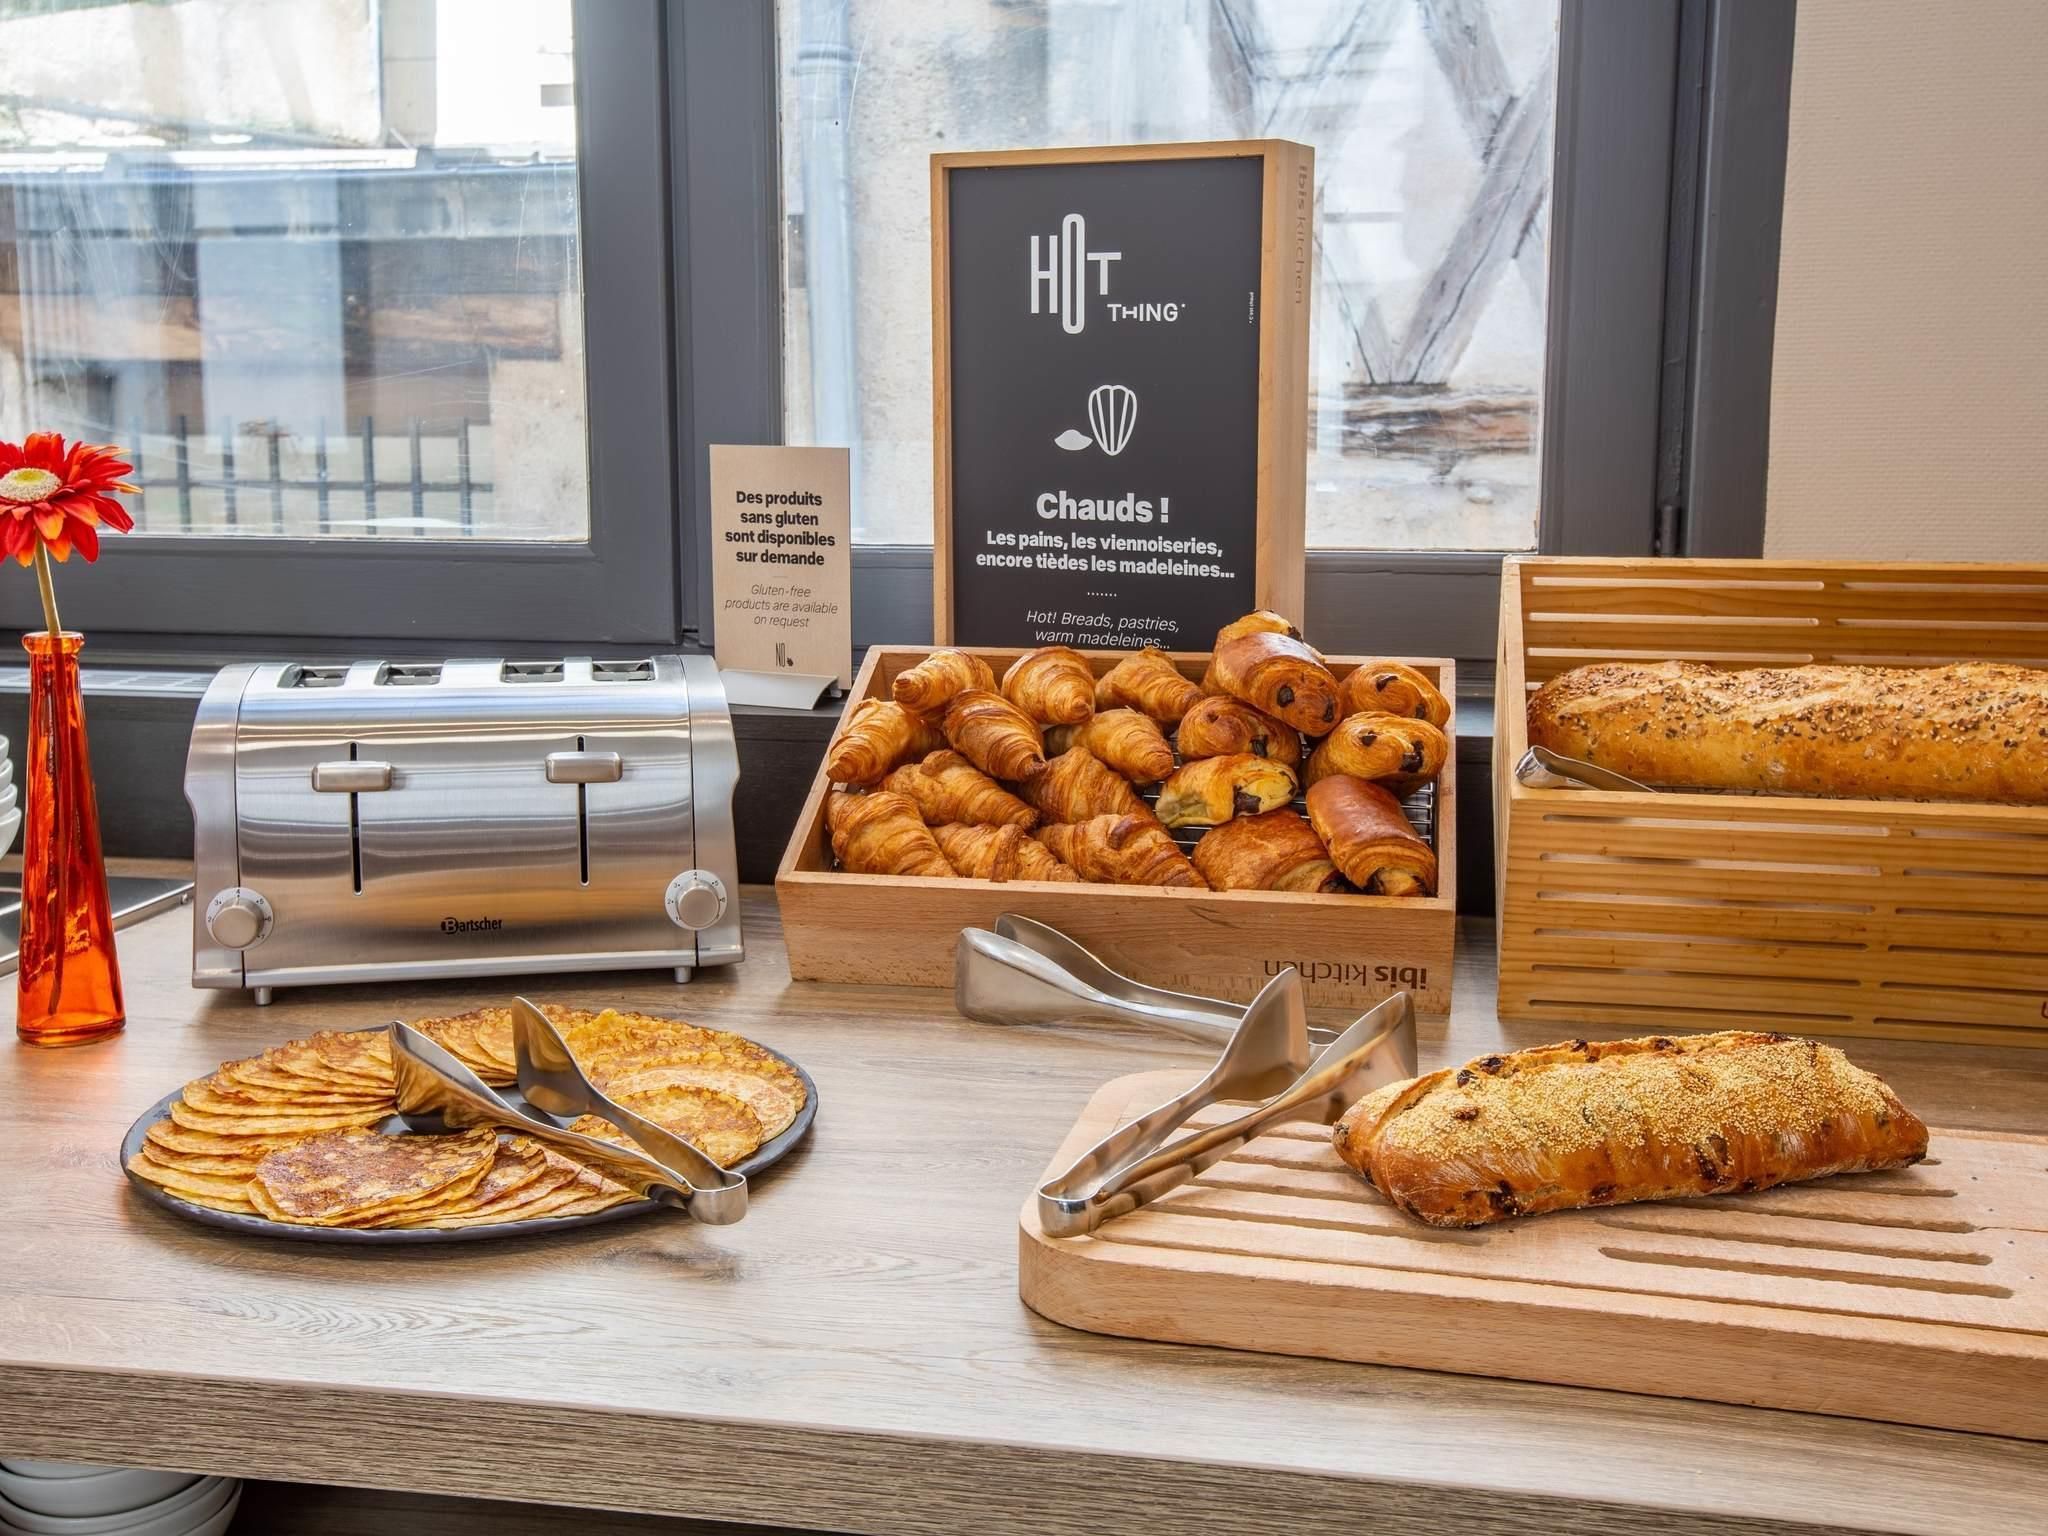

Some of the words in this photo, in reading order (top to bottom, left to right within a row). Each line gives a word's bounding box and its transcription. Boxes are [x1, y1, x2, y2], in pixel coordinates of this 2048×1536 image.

[1030, 213, 1122, 335] HOT
[736, 490, 763, 504] Des
[765, 491, 822, 507] produits
[1036, 490, 1153, 523] Chauds
[740, 511, 773, 525] sans
[775, 511, 819, 528] gluten
[725, 530, 756, 544] sont
[757, 531, 835, 547] disponibles
[986, 530, 1016, 547] Les
[1019, 531, 1069, 551] pains,
[1071, 532, 1097, 550] les
[1100, 534, 1224, 558] viennoiseries,
[736, 550, 758, 563] sur
[760, 550, 825, 565] demande
[976, 553, 1033, 569] encore
[1036, 552, 1089, 572] tièdes
[1091, 555, 1117, 573] les
[1119, 559, 1236, 579] madeleines...
[751, 583, 812, 598] Gluten-free
[724, 599, 771, 611] products
[772, 601, 790, 612] are
[792, 601, 839, 615] available
[753, 616, 768, 626] on
[769, 616, 810, 629] request
[1026, 610, 1058, 625] Hot!
[1061, 612, 1115, 629] Breads,
[1118, 616, 1180, 633] pastries,
[1035, 630, 1074, 644] warm
[440, 916, 503, 935] Bartscher
[1264, 960, 1367, 987] kitchn
[1374, 965, 1427, 990] ibis
